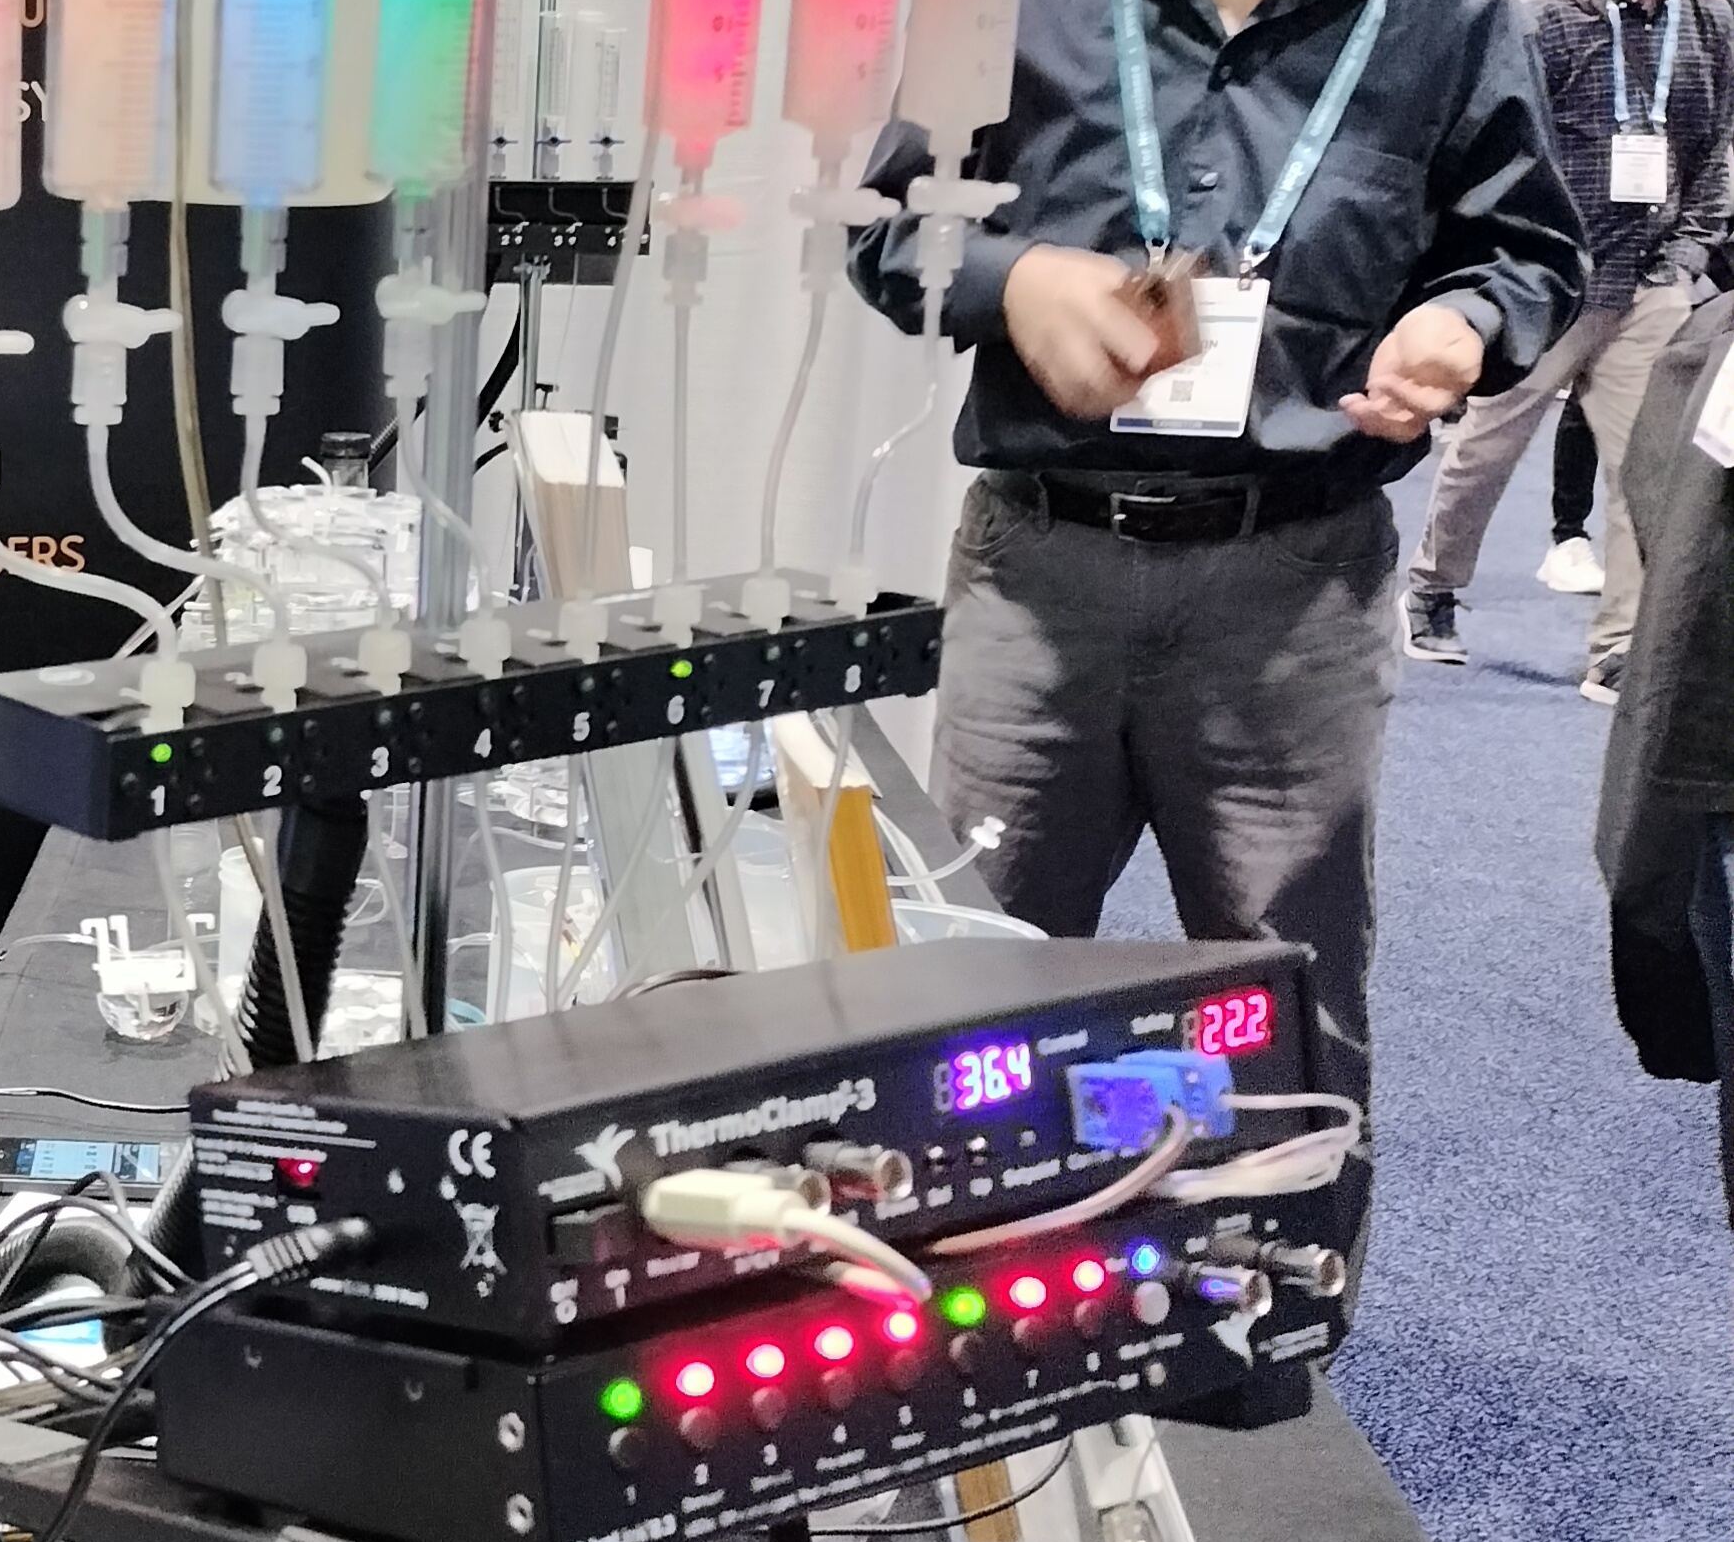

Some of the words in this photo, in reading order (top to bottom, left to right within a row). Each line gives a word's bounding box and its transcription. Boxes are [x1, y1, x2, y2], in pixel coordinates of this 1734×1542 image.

[757, 679, 776, 708] 7
[844, 663, 863, 694] 8
[667, 695, 685, 725] 6
[572, 712, 591, 742] 5
[473, 728, 492, 758] 4
[371, 747, 390, 778] 3
[262, 765, 283, 797] 2
[150, 785, 166, 816] 1
